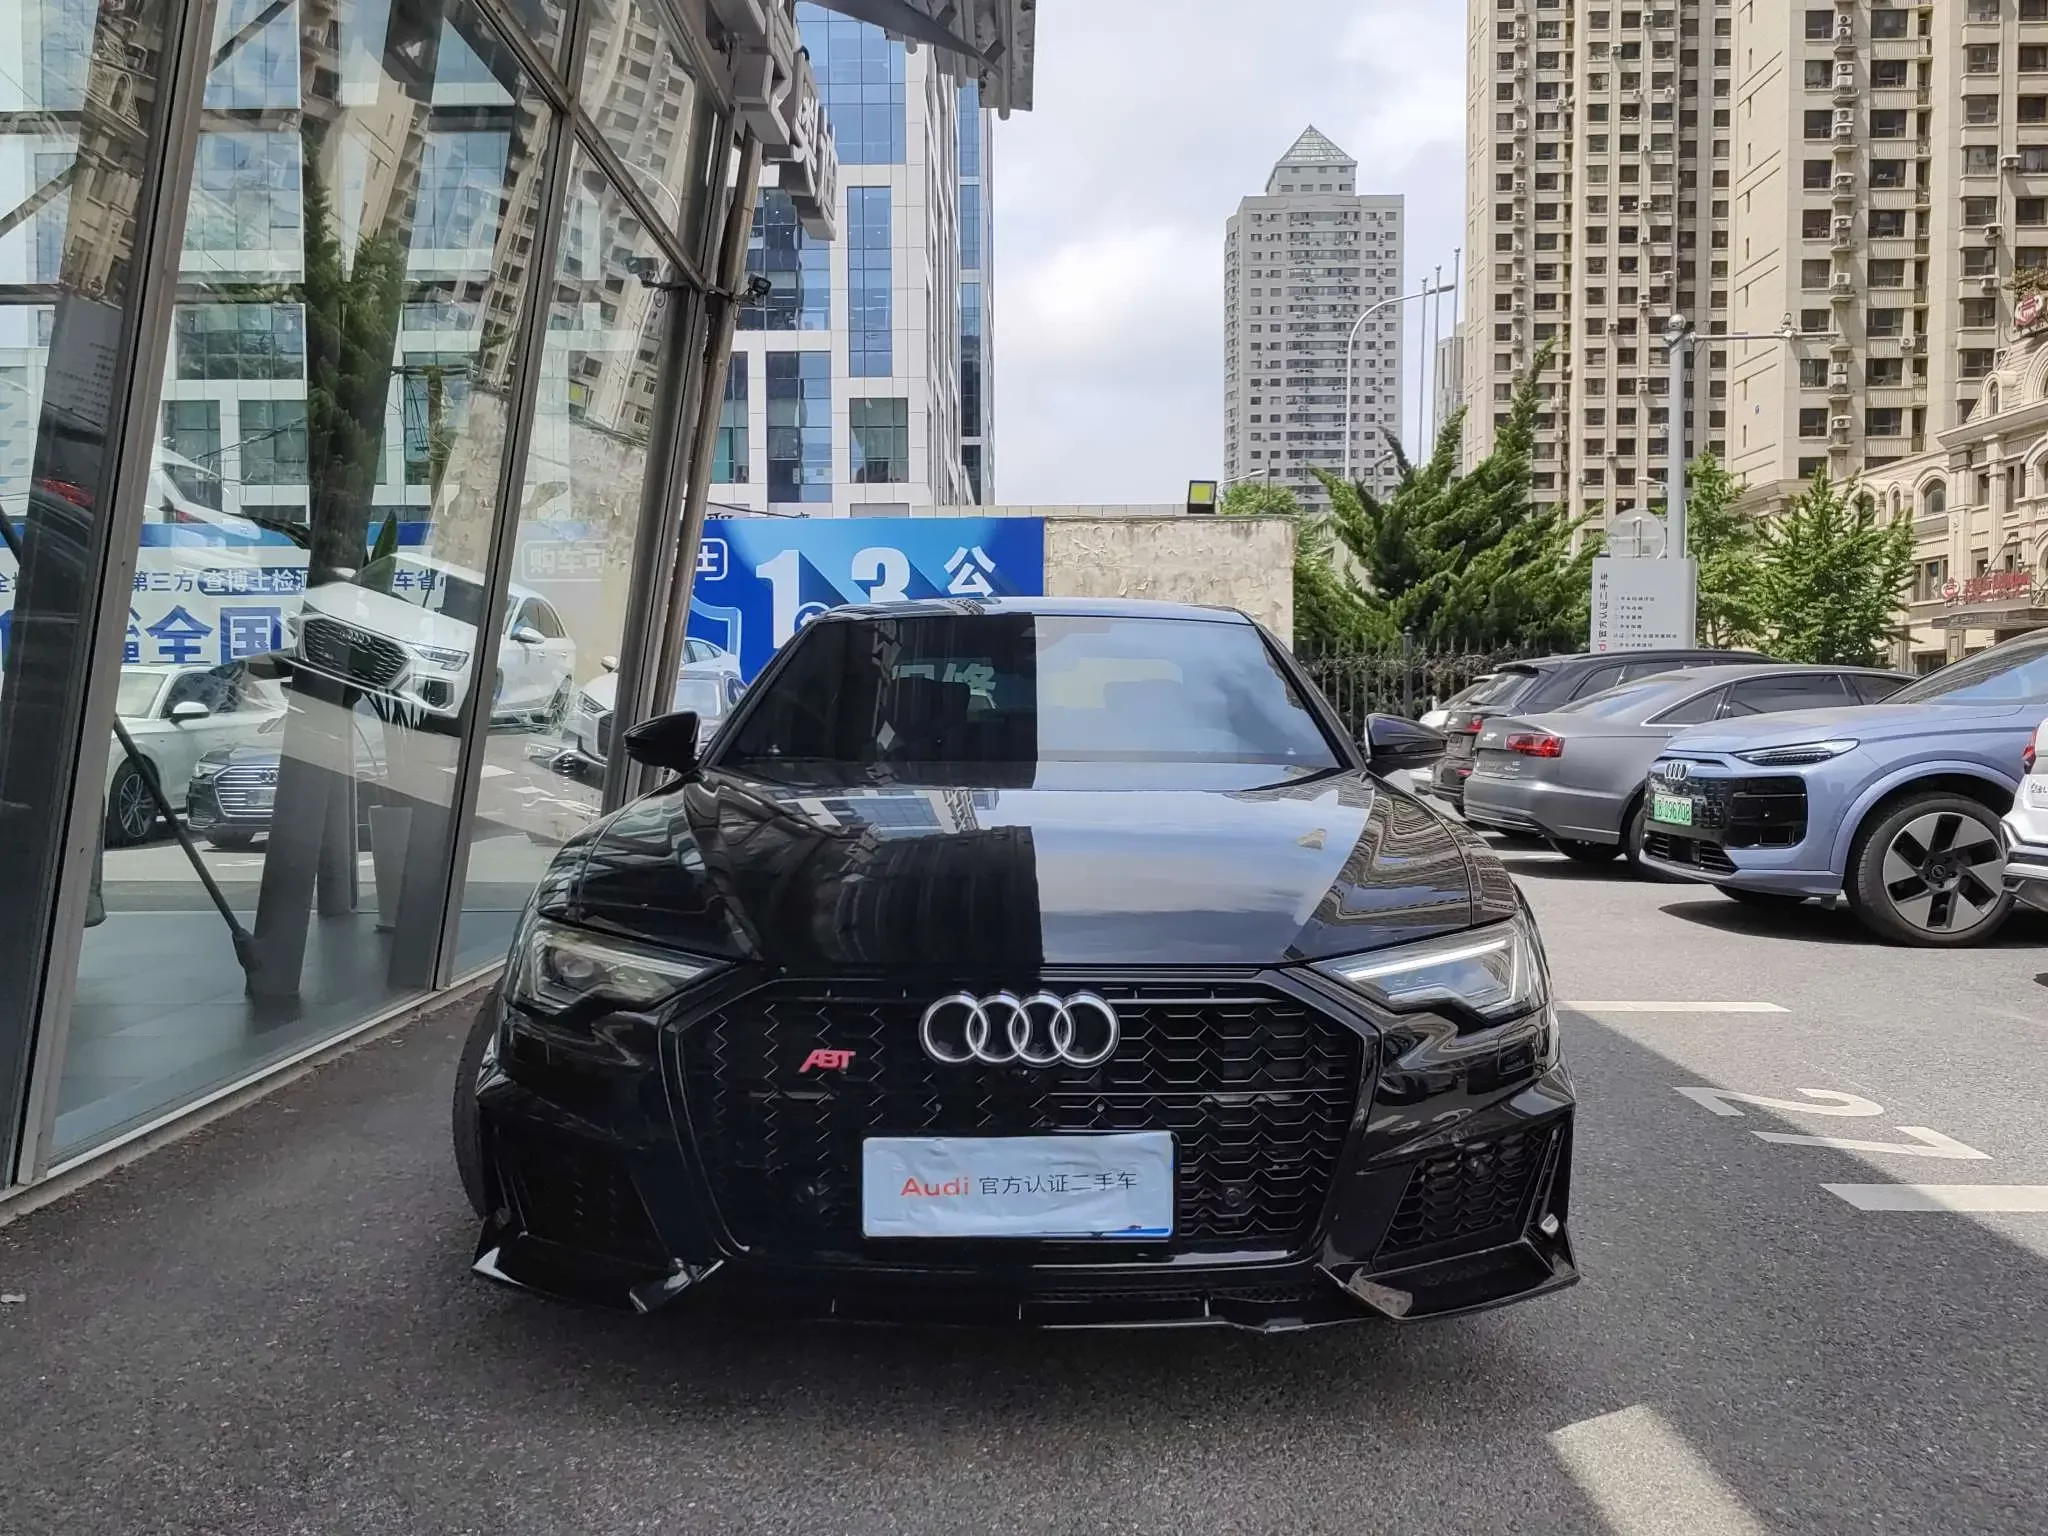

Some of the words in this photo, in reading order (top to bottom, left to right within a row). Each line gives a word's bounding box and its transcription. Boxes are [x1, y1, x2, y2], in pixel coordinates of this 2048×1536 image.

[393, 569, 445, 591] 车省
[799, 1049, 856, 1073] ABT
[900, 1176, 969, 1196] Audi
[979, 1171, 1138, 1195] 官方认证二手车
